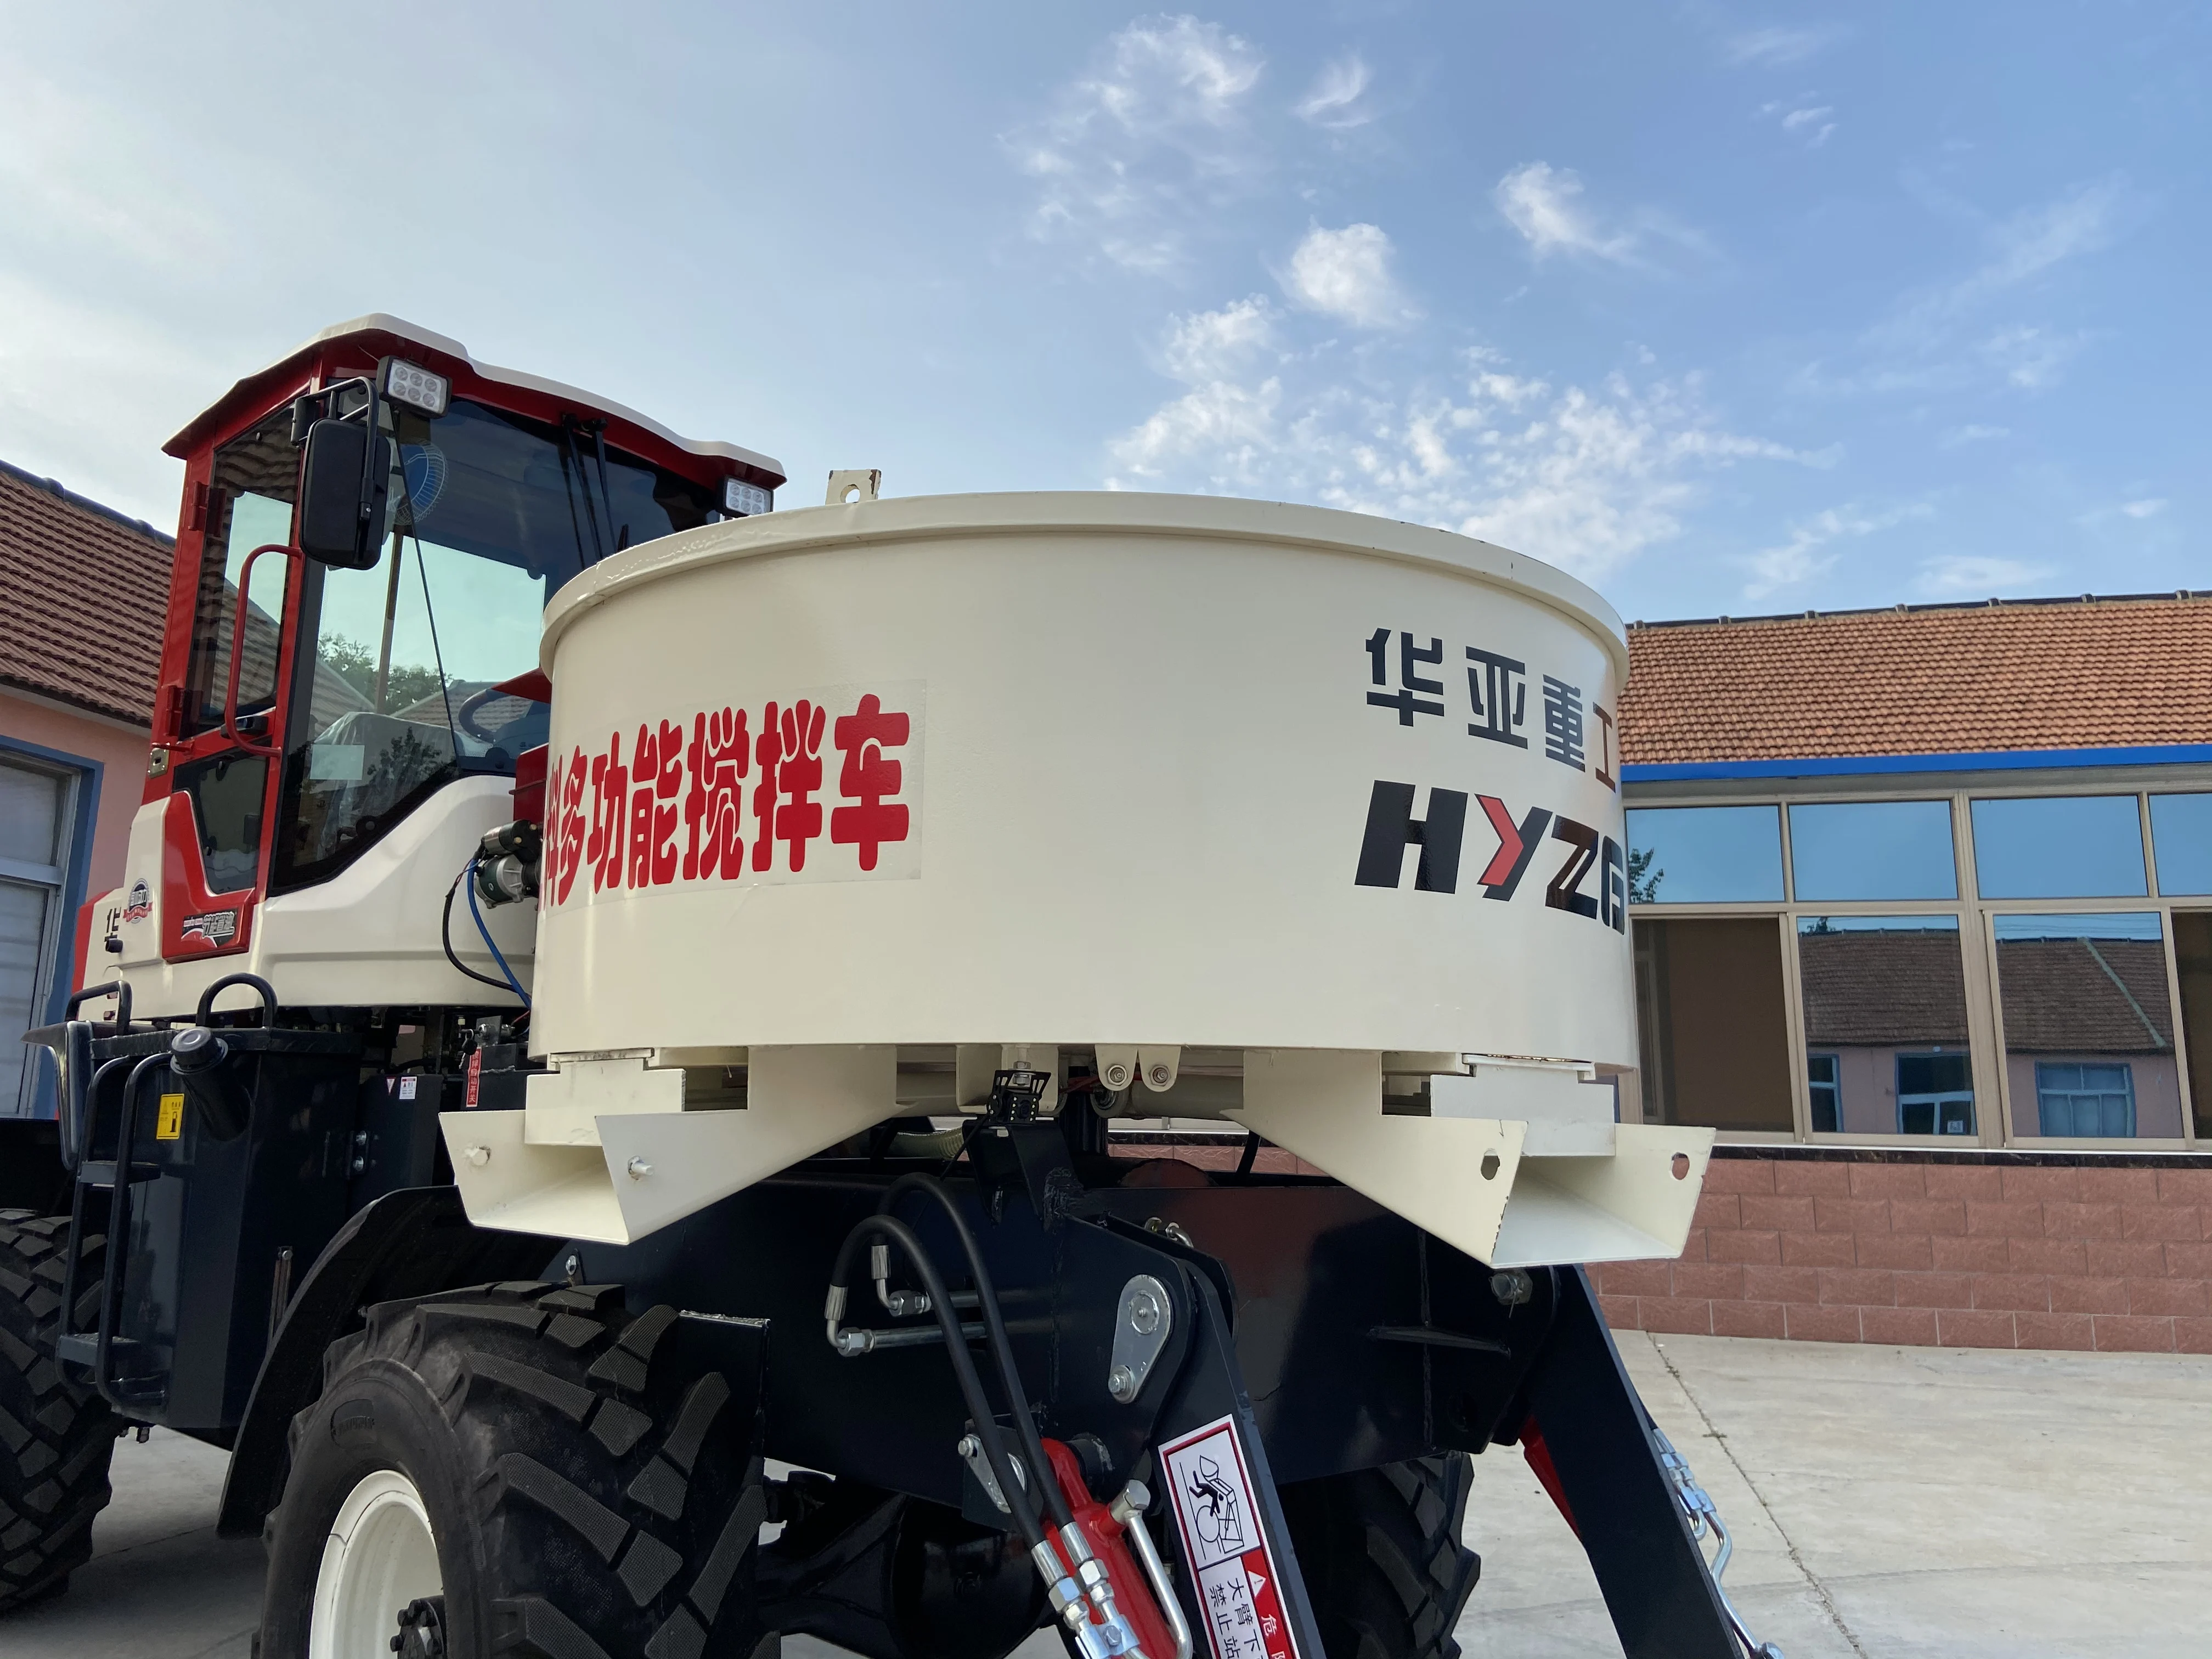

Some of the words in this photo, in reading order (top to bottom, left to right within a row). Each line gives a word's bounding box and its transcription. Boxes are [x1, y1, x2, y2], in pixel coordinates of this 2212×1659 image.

[1365, 628, 1616, 793] 华亚重工
[1355, 780, 1624, 935] HYZG
[1227, 1578, 1263, 1659] 大臂下
